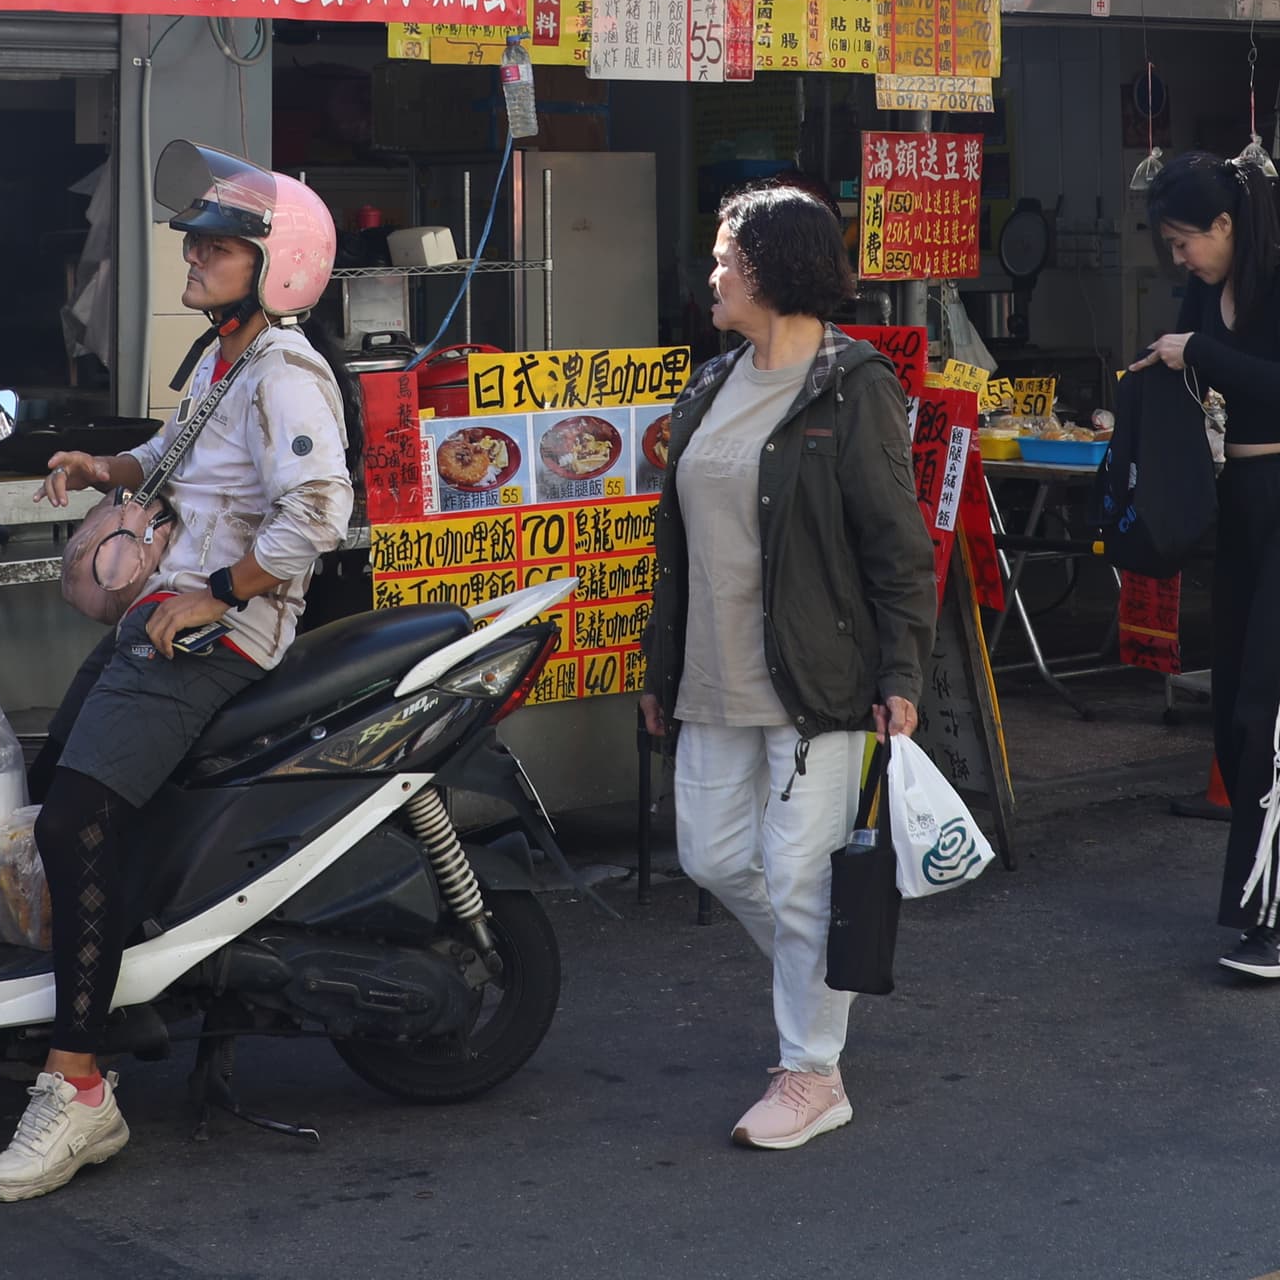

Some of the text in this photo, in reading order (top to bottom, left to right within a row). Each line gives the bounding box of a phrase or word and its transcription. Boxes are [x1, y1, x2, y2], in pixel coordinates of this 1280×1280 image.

[915, 17, 934, 38] 65
[690, 19, 723, 65] 55
[756, 55, 773, 67] 25
[782, 56, 799, 67] 25
[831, 57, 847, 69] 30
[861, 58, 869, 69] 6
[913, 47, 933, 68] 65
[868, 138, 982, 183] 滿額送豆漿
[866, 193, 883, 269] 消費
[474, 348, 691, 409] 日式濃厚咖哩
[987, 380, 1014, 407] 55
[1021, 394, 1047, 417] 50
[444, 488, 519, 509] 炸豬排飯 55
[606, 480, 621, 496] 55
[372, 518, 516, 572] 旗魚丸咖哩飯
[521, 514, 565, 556] 70
[585, 656, 617, 694] 40
